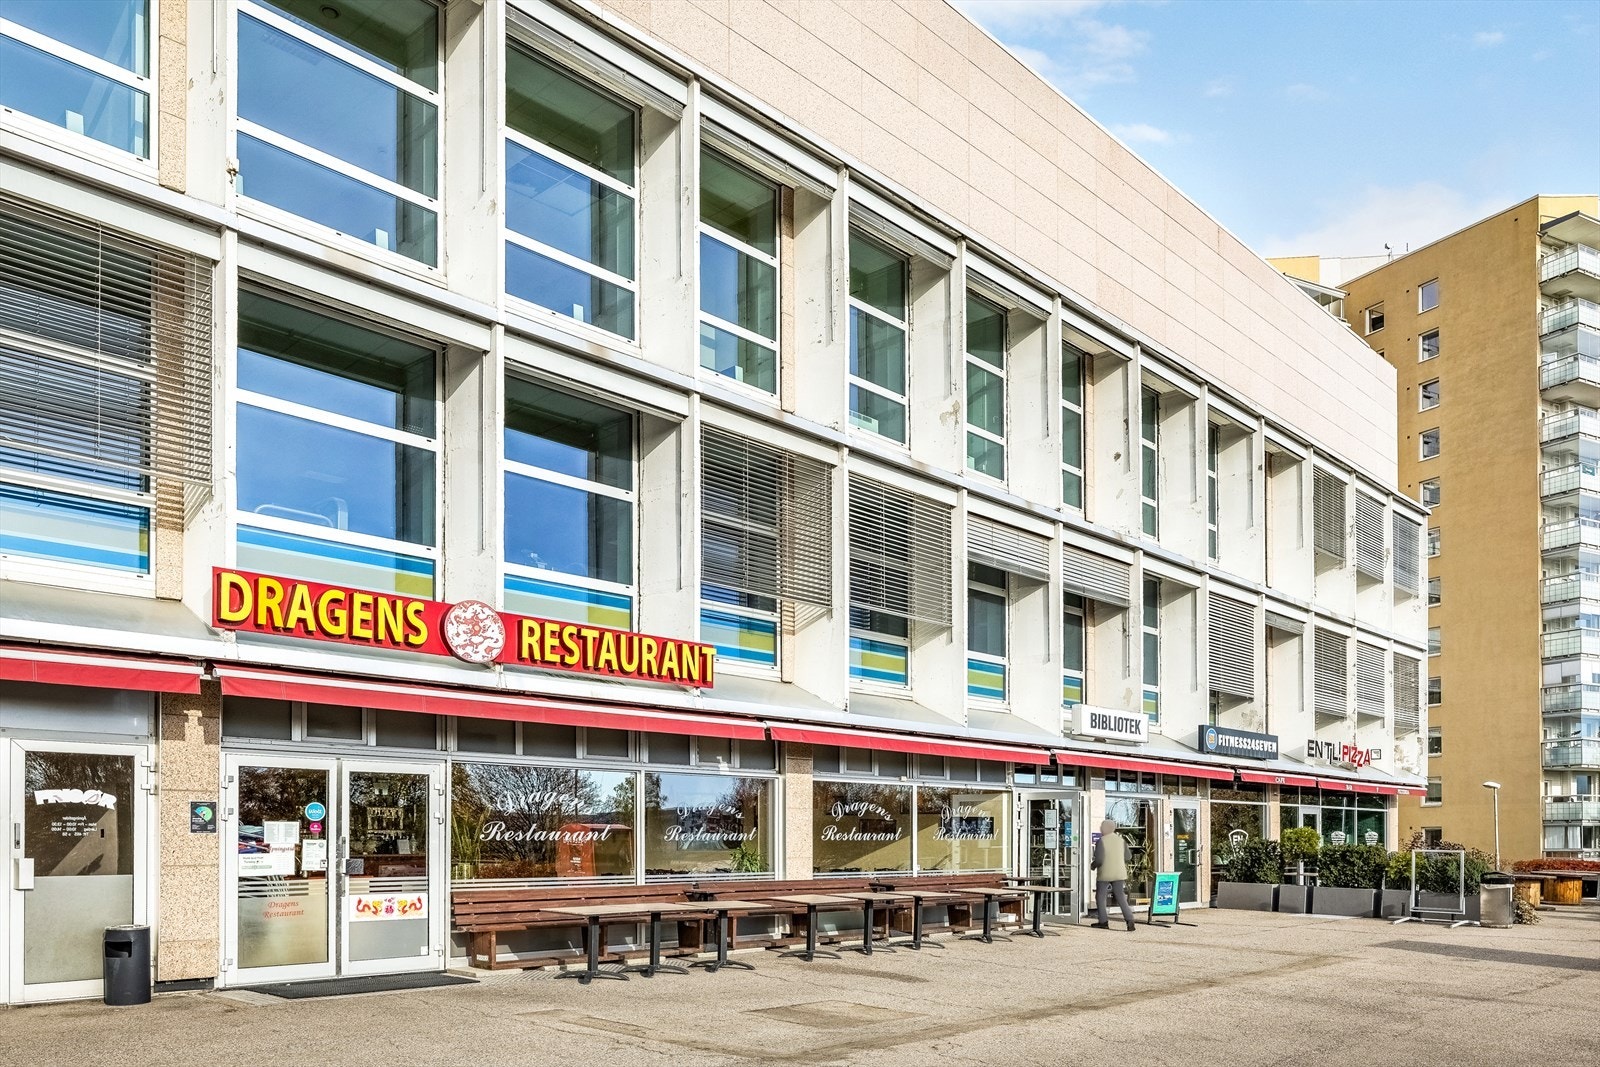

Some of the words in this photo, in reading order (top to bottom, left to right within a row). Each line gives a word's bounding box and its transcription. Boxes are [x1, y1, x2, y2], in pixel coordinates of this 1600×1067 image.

[218, 571, 428, 646] DRAGENS
[520, 618, 717, 684] RESTAURANT
[1090, 712, 1142, 735] BIBLIOTEK
[1217, 734, 1277, 753] FITNESS24SEVEN
[831, 800, 894, 822] Dragens
[479, 820, 613, 842] Restaurant
[663, 824, 757, 842] Restaurant
[821, 824, 903, 841] Restaurant
[932, 826, 1000, 841] Restaurant
[263, 910, 304, 919] Restaurant
[268, 901, 299, 910] Dragens
